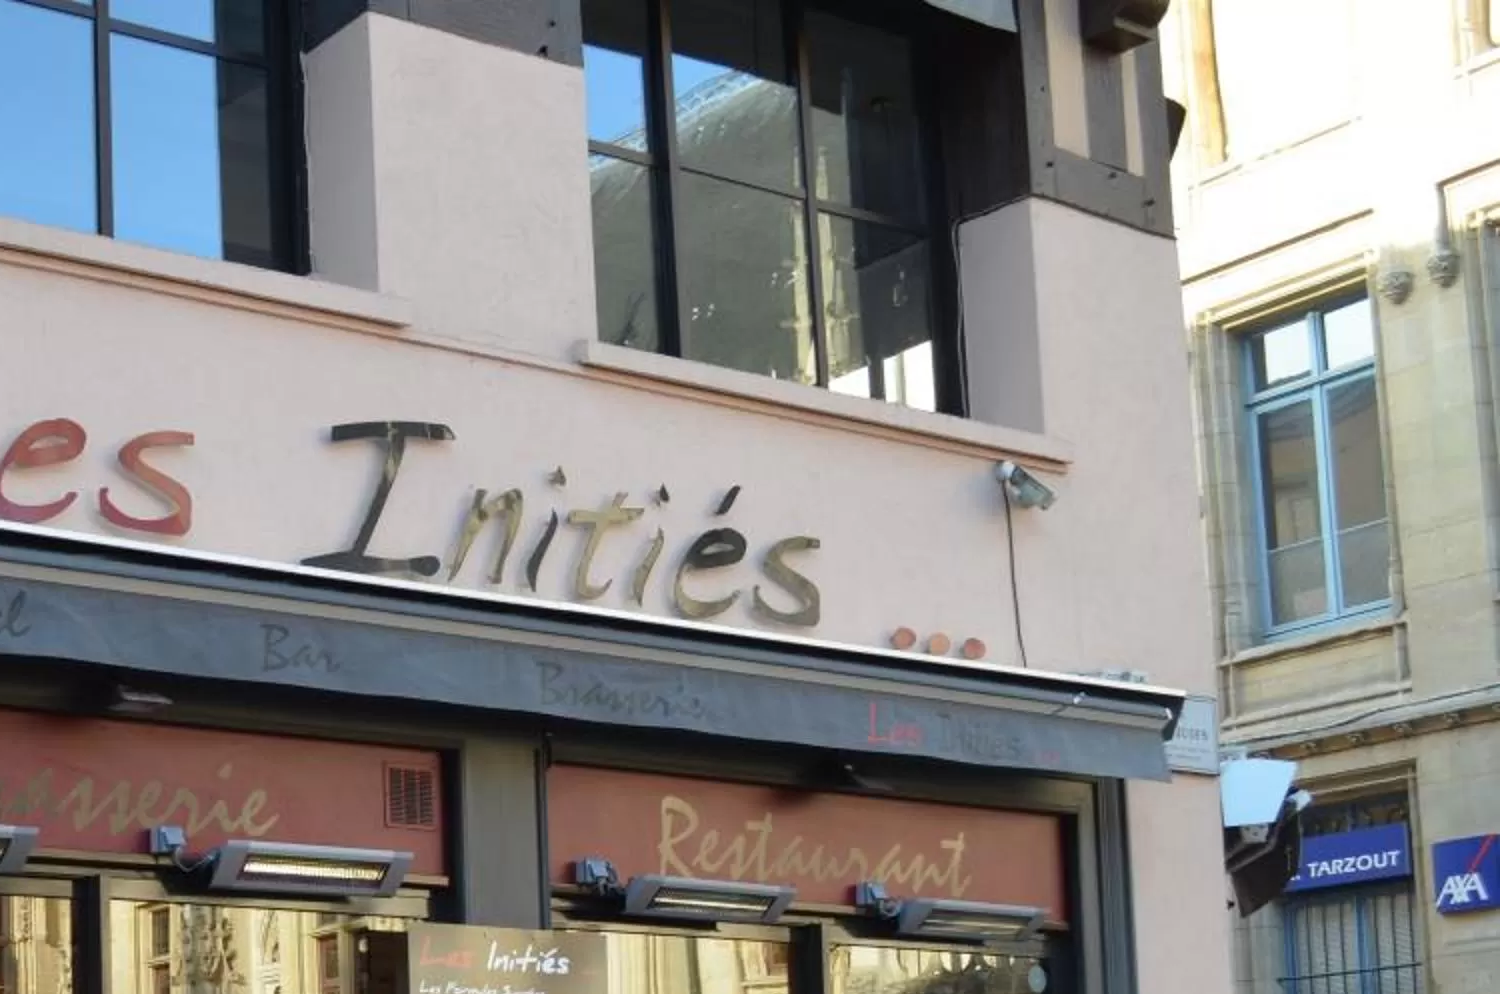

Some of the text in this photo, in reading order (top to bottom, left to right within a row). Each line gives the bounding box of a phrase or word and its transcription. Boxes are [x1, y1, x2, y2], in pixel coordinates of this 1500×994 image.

[300, 420, 822, 627] Initiés
[259, 623, 343, 673] Bar
[657, 795, 974, 898] Restaurant
[1306, 850, 1401, 878] TARZOUT
[1435, 871, 1489, 907] AXA
[486, 939, 572, 975] Initiés
